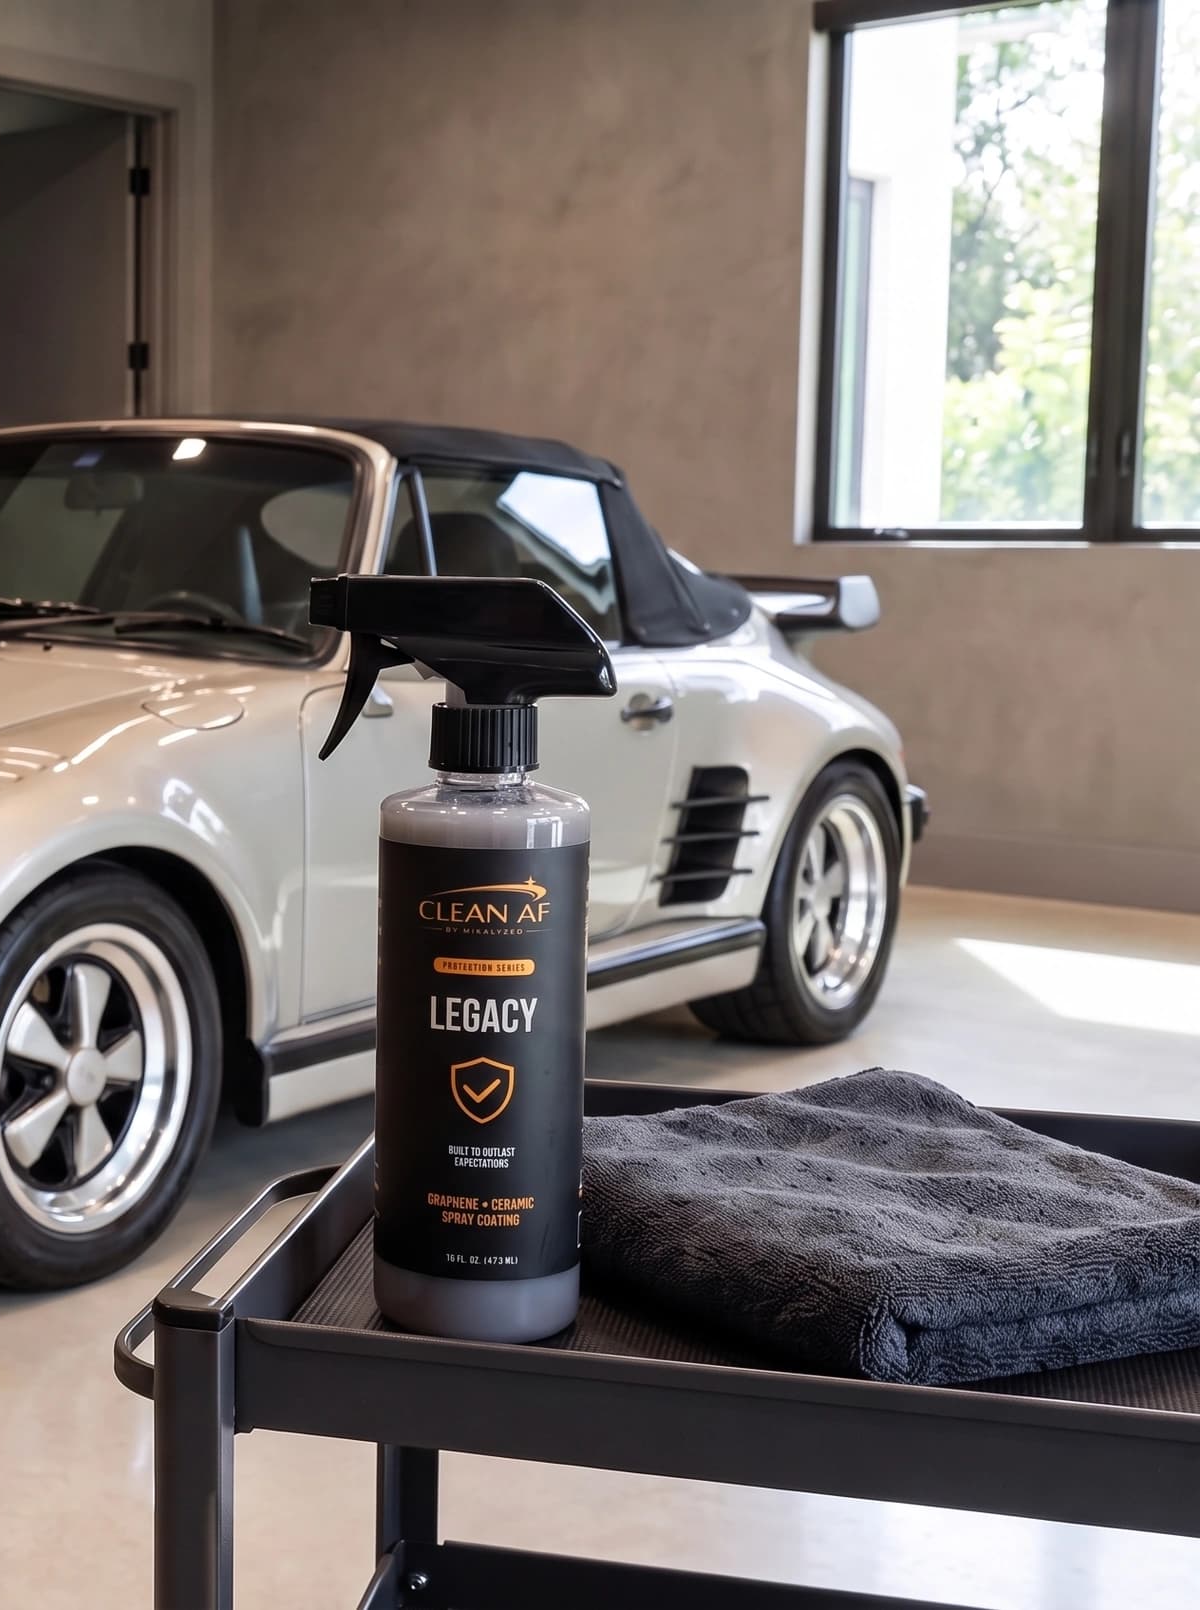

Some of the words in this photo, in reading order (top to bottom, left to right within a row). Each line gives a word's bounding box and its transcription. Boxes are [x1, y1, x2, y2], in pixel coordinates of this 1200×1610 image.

[419, 901, 508, 923] CLEAN
[516, 902, 550, 923] AF
[430, 995, 538, 1033] LEGACY
[448, 1144, 469, 1156] BUILT
[470, 1146, 481, 1157] TO
[482, 1146, 516, 1157] OUTLAST
[427, 1192, 479, 1211] GRAPHENE
[491, 1196, 535, 1211] CERAMIC
[442, 1210, 474, 1225] SPRAY
[477, 1213, 520, 1227] COATING
[446, 1253, 455, 1263] 16
